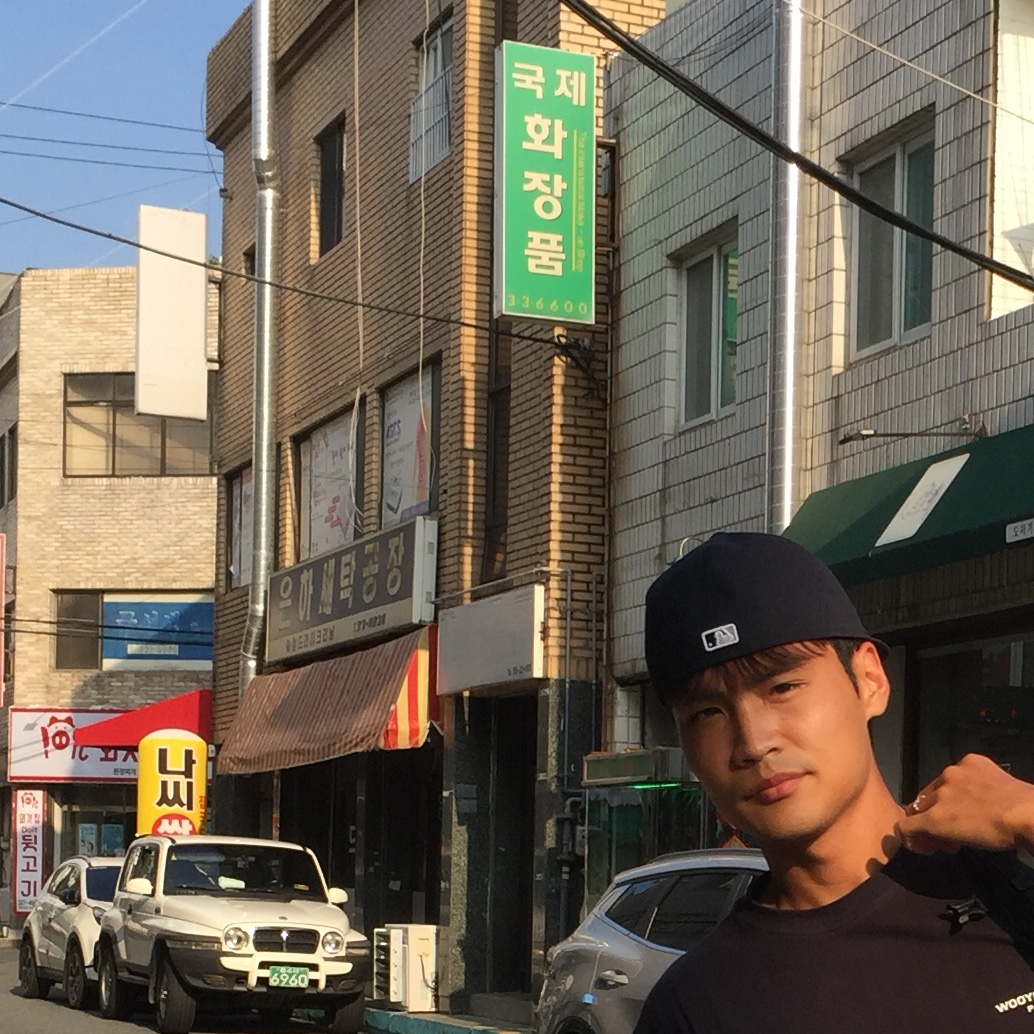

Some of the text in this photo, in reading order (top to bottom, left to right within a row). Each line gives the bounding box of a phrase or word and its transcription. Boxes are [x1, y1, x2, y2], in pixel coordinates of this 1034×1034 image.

[512, 62, 587, 107] 국제
[522, 113, 568, 277] 화장품
[20, 834, 38, 897] 뒷고기
[271, 973, 308, 988] 6960
